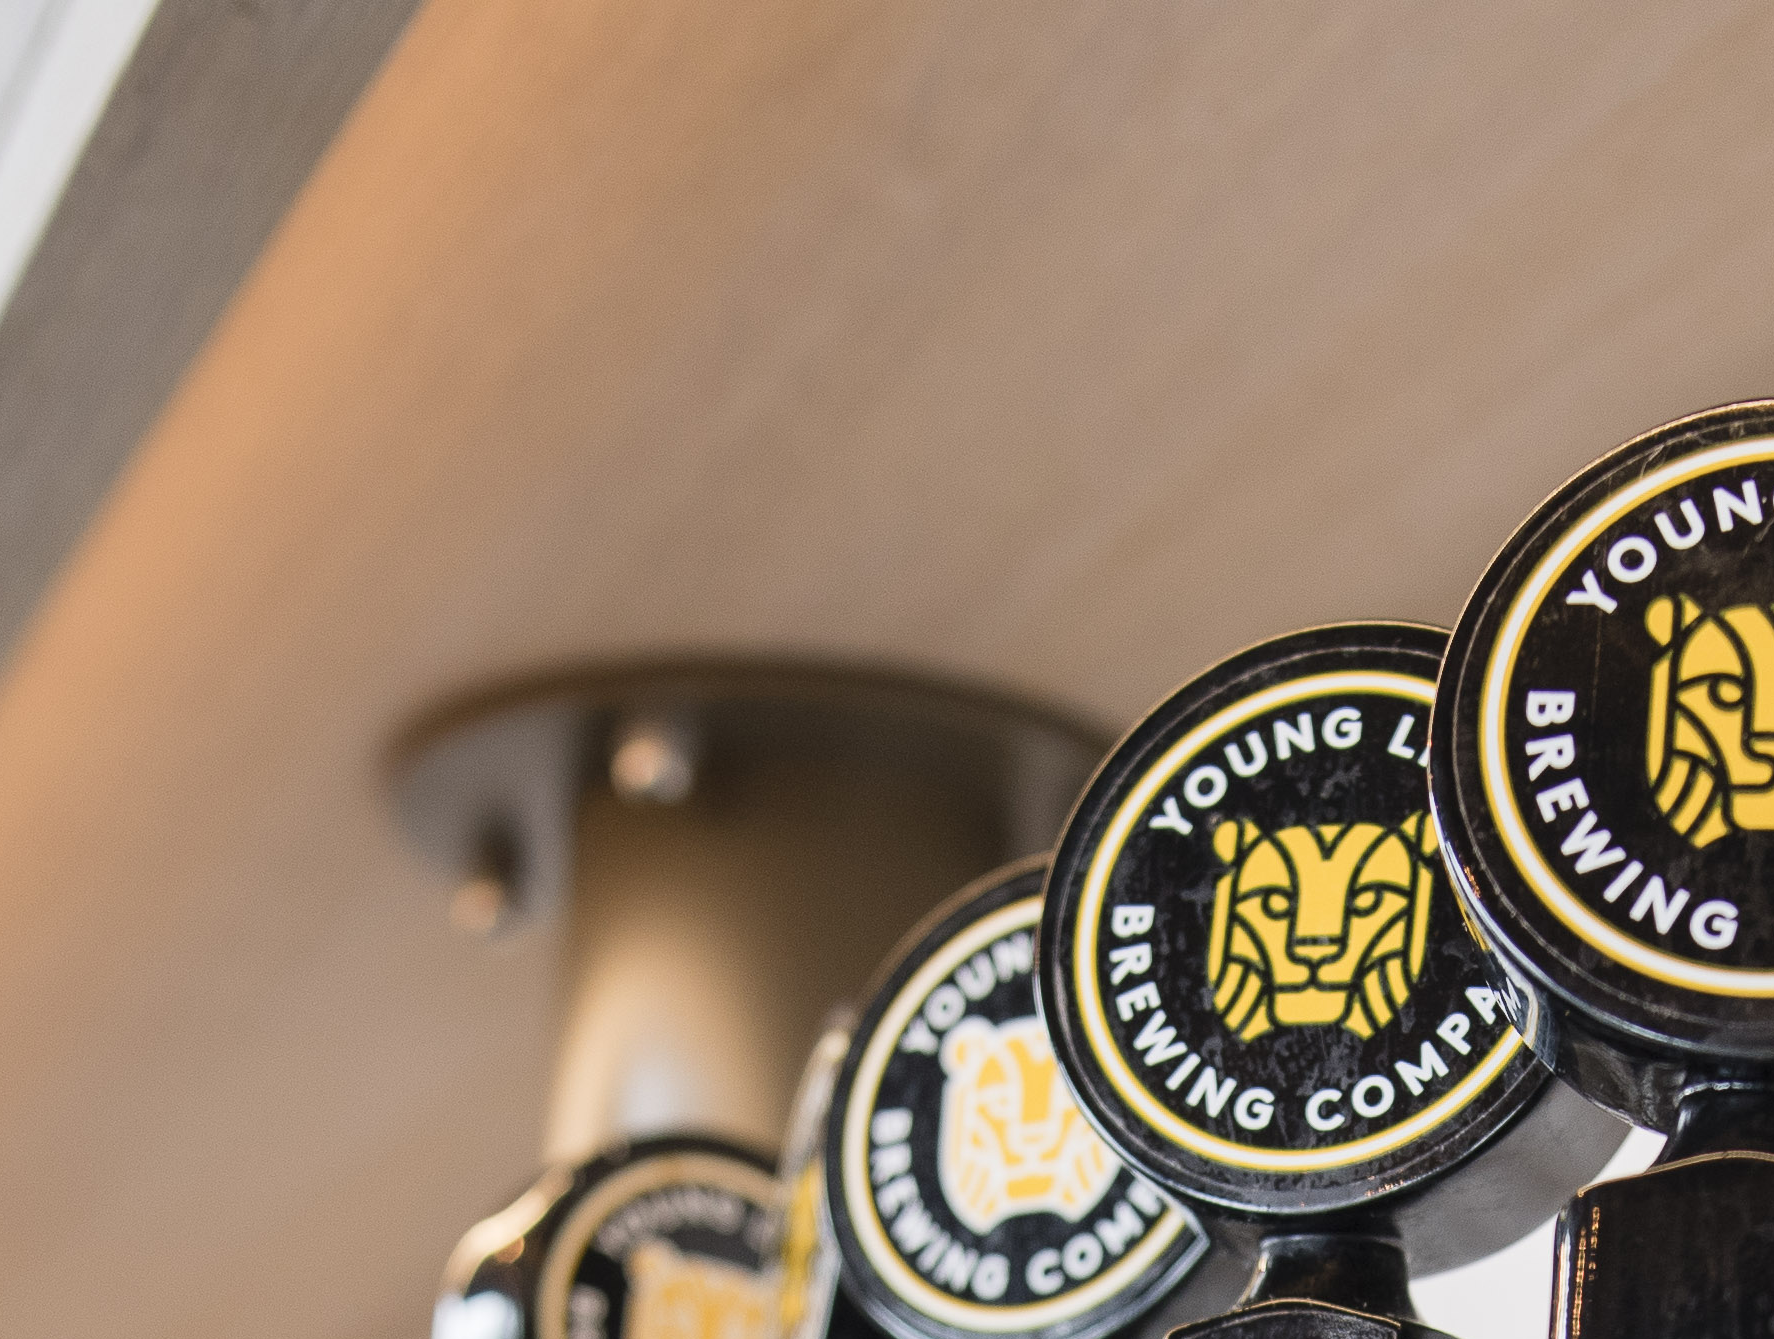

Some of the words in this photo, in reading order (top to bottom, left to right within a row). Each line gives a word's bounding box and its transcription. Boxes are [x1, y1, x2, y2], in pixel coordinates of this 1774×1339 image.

[1149, 706, 1363, 838] YOUNG
[1526, 689, 1739, 950] BREWING
[1109, 903, 1275, 1131] BREWING
[870, 1107, 1011, 1300] BREWING
